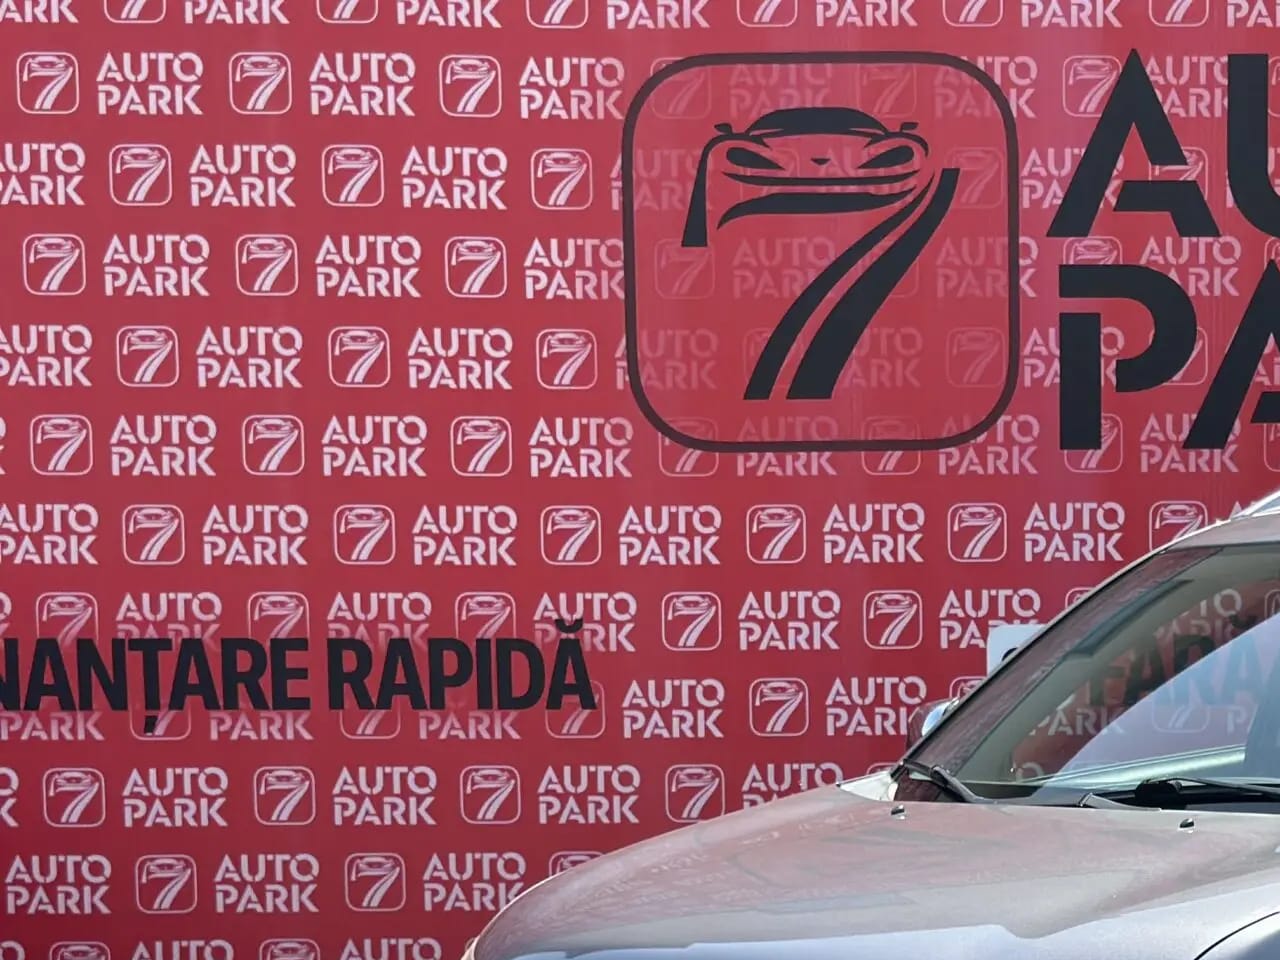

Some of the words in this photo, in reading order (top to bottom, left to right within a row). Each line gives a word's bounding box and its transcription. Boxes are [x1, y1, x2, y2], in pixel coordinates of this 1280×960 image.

[185, 0, 289, 24] PARK
[397, 0, 501, 28] PARK
[607, 0, 709, 29] PARK
[816, 0, 917, 26] PARK
[1022, 0, 1121, 27] PARK
[96, 52, 203, 82] AUTO
[309, 53, 415, 83] AUTO
[519, 57, 624, 87] AUTO
[98, 84, 203, 115] PARK
[311, 84, 415, 116] PARK
[520, 89, 623, 119] PARK
[0, 143, 85, 173] UTO
[189, 144, 296, 174] AUTO
[401, 146, 507, 177] AUTO
[0, 175, 84, 205] ARK
[191, 176, 295, 207] PARK
[403, 178, 507, 210] PARK
[103, 234, 209, 264] AUTO
[315, 235, 421, 265] AUTO
[524, 238, 623, 267] AUTO
[1140, 236, 1241, 264] AUTO
[104, 266, 209, 296] PARK
[317, 266, 420, 297] PARK
[525, 269, 624, 299] PARK
[196, 326, 302, 356] AUTO
[408, 328, 512, 358] AUTO
[197, 358, 302, 388] PARK
[409, 359, 512, 389] PARK
[110, 415, 216, 444] AUTO
[322, 416, 427, 445] AUTO
[529, 417, 633, 446] AUTO
[111, 446, 216, 476] PARK
[323, 446, 426, 476] PARK
[530, 448, 632, 477] PARK
[940, 446, 1037, 474] PARK
[202, 505, 308, 534] AUTO
[412, 505, 517, 535] AUTO
[618, 505, 721, 534] AUTO
[823, 503, 924, 532] AUTO
[1024, 502, 1125, 530] AUTO
[203, 536, 307, 565] PARK
[414, 536, 516, 565] PARK
[620, 536, 720, 565] PARK
[824, 533, 923, 563] PARK
[1025, 532, 1123, 562] PARK
[116, 592, 222, 621] AUTO
[327, 592, 431, 620] AUTO
[533, 592, 637, 621] AUTO
[738, 590, 840, 619] AUTO
[939, 589, 1040, 618] AUTO
[740, 621, 839, 650] PARK
[327, 618, 598, 711] RAPIDĂ
[622, 679, 724, 708] AUTO
[825, 676, 926, 705] AUTO
[0, 712, 104, 740] PARK
[211, 713, 313, 740] PARK
[420, 711, 520, 739] PARK
[624, 709, 723, 738] PARK
[122, 767, 228, 796] AUTO
[332, 766, 436, 794] AUTO
[538, 765, 640, 793] AUTO
[742, 762, 843, 792] AUTO
[124, 798, 227, 827] PARK
[334, 796, 436, 825] PARK
[539, 795, 638, 824] PARK
[6, 855, 111, 883] AUTO
[214, 853, 319, 882] AUTO
[423, 852, 525, 880] AUTO
[7, 885, 110, 914] PARK
[216, 884, 318, 912] PARK
